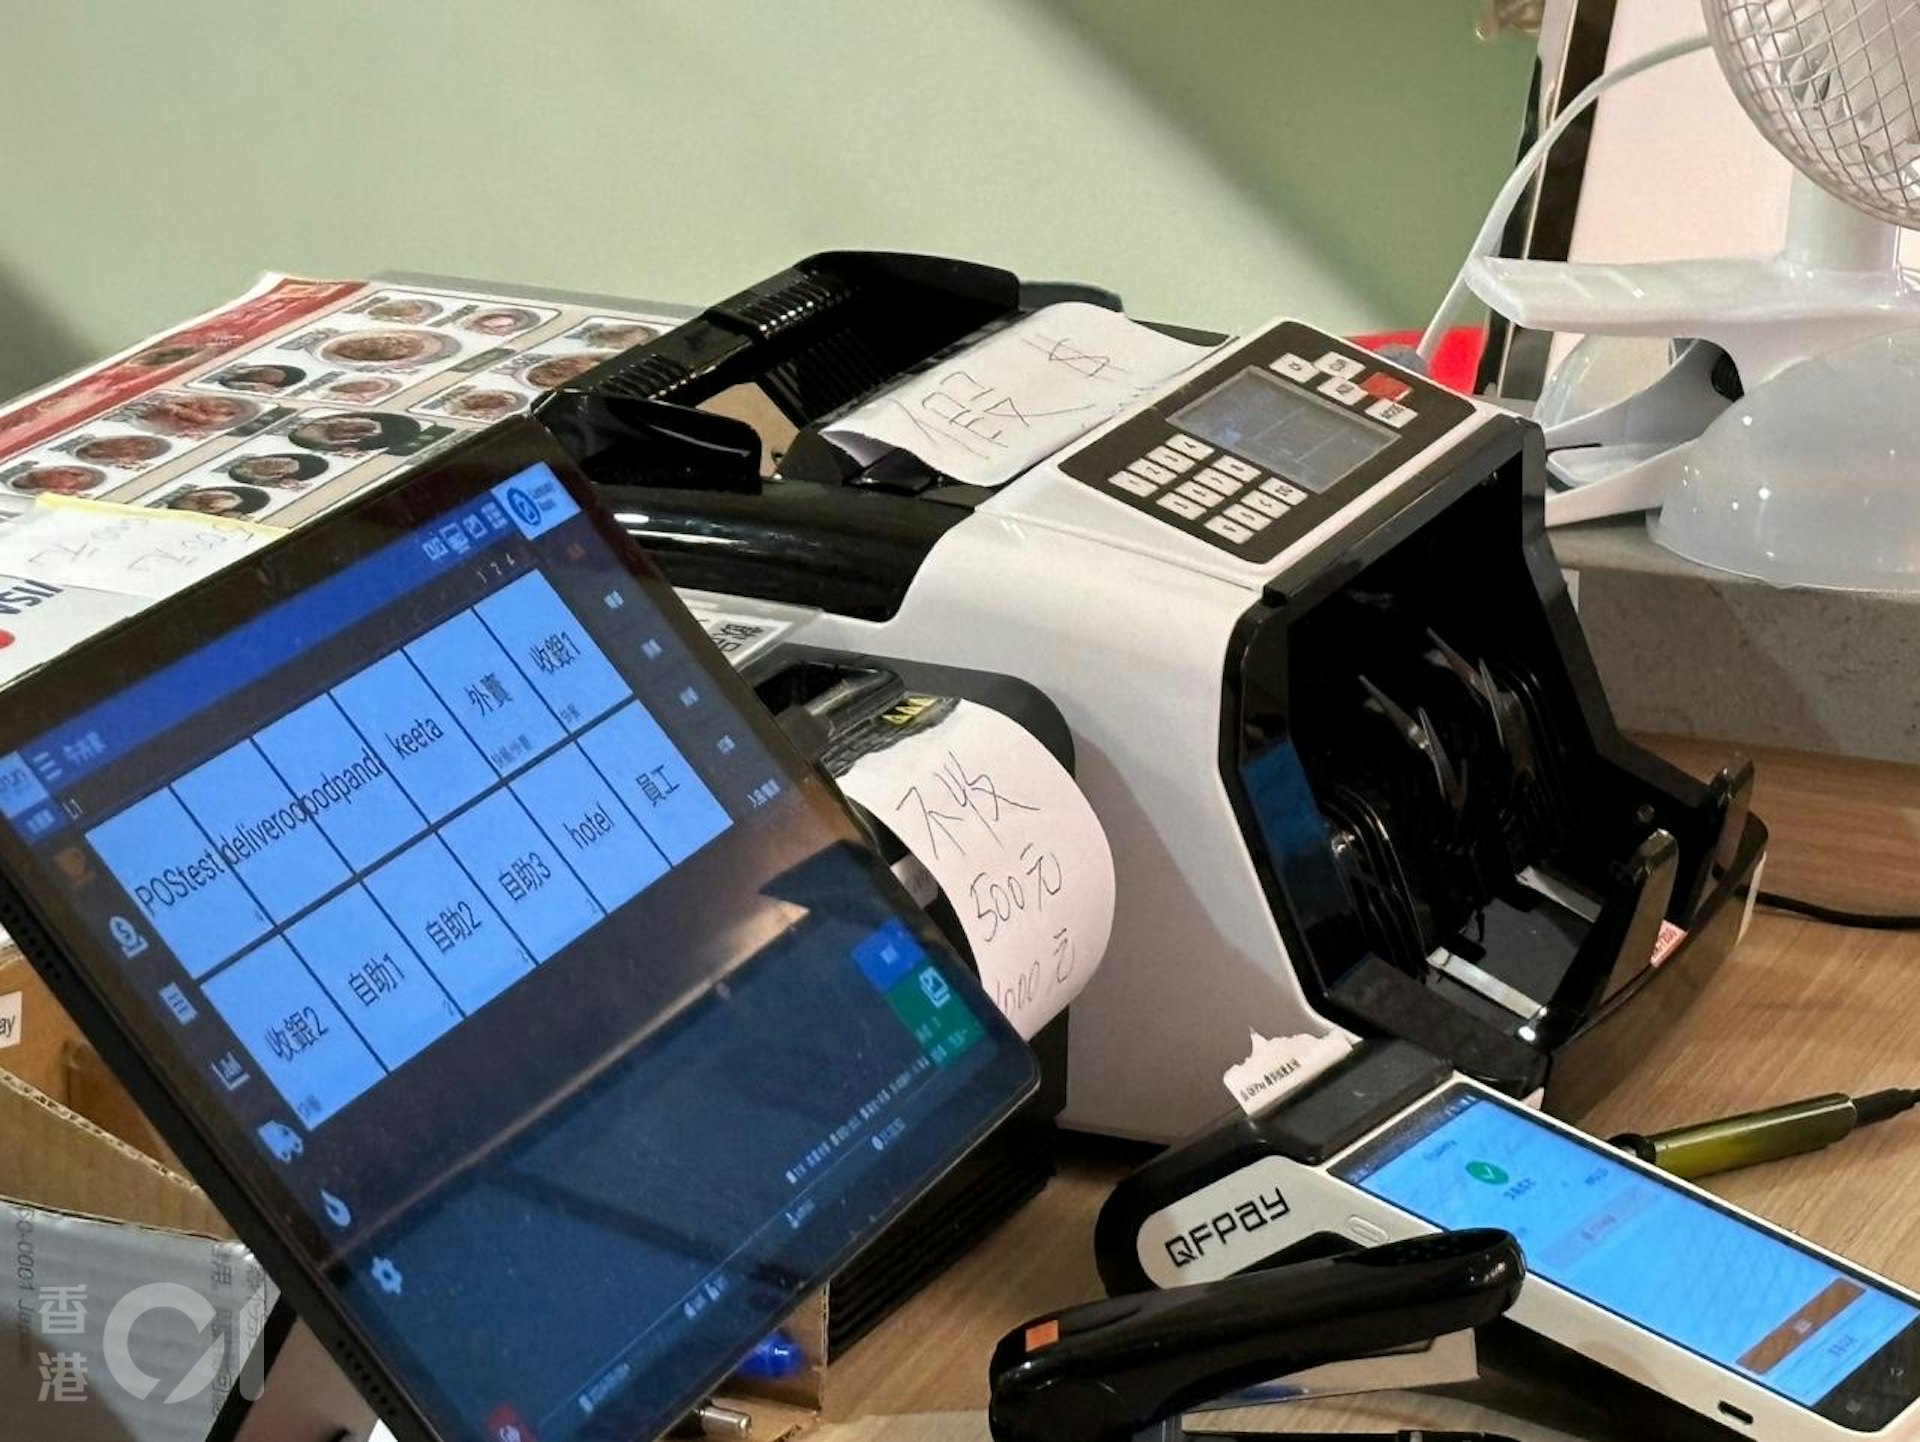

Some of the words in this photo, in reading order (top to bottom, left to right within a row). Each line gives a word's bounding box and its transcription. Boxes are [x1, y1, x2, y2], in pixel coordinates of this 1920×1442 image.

[385, 717, 445, 760] keeta
[636, 764, 680, 807] 員工
[896, 749, 1040, 860] 不收
[562, 801, 615, 850] hotel
[134, 848, 226, 916] POStest
[499, 852, 552, 902] 自助3
[970, 843, 1062, 942] 500元
[425, 901, 483, 955] 自助2
[348, 953, 406, 1007] 自助1
[264, 1005, 330, 1063] 收銀2
